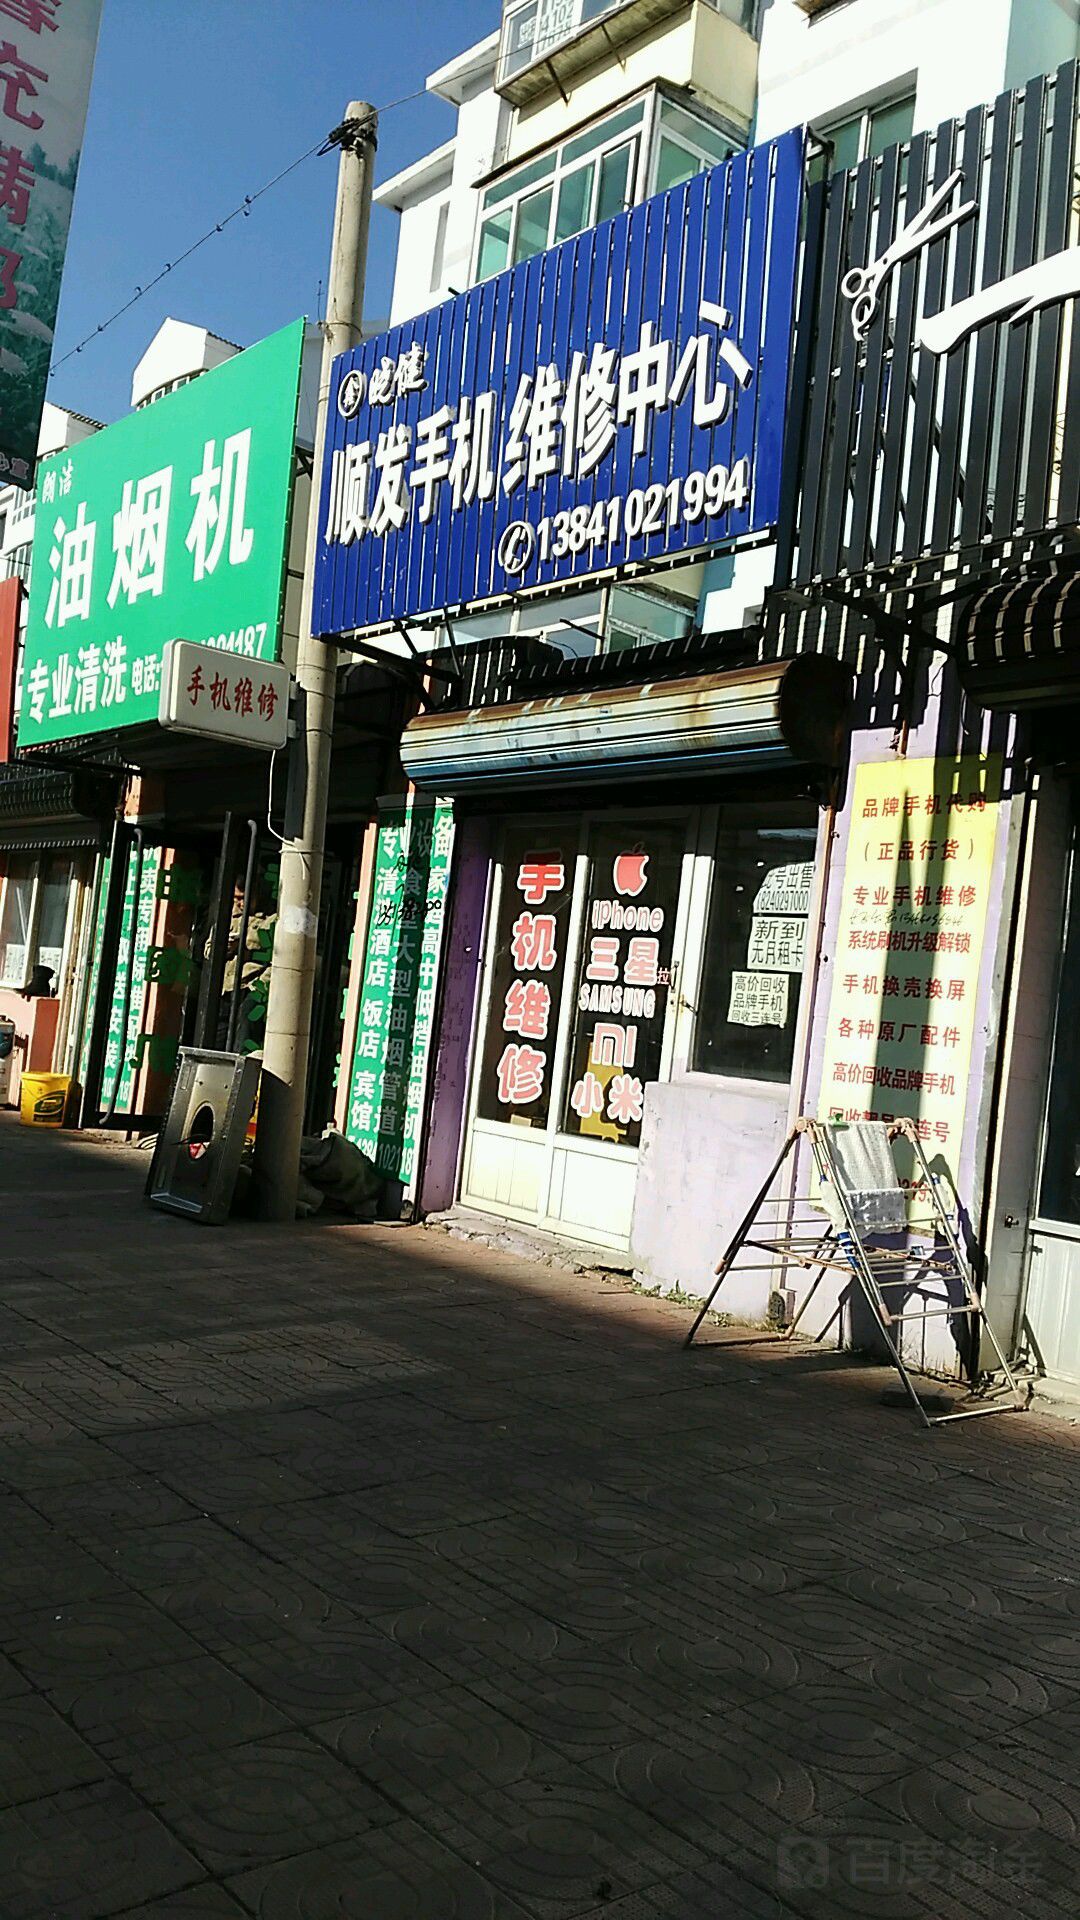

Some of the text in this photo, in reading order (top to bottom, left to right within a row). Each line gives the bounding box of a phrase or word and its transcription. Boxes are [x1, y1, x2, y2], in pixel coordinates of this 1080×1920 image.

[324, 299, 753, 546] 顺发手机维修中心
[536, 459, 749, 560] 13841021994
[44, 427, 255, 629] 油烟机
[27, 636, 127, 724] 专业清洗
[187, 665, 278, 721] 手机维修
[862, 794, 986, 818] 品牌手机代购
[853, 886, 977, 907] 专业手机维修
[592, 900, 664, 932] iPhone
[755, 920, 805, 940] 新到
[752, 940, 803, 966] 无月租卡
[848, 931, 972, 953] 系统刷机升级解锁
[497, 849, 564, 1104] 手机维修
[586, 937, 659, 985] 三星
[657, 967, 670, 985] 拉
[735, 975, 786, 993] 高价回收
[843, 974, 966, 1001] 手机换壳换屏
[579, 983, 655, 1018] SAMSUNG
[733, 993, 783, 1011] 品牌手机
[732, 1010, 782, 1024] 回收三连号
[838, 1017, 961, 1048] 各种原厂配件
[833, 1062, 956, 1096] 高价回收品牌手机
[571, 1072, 643, 1123] 小米
